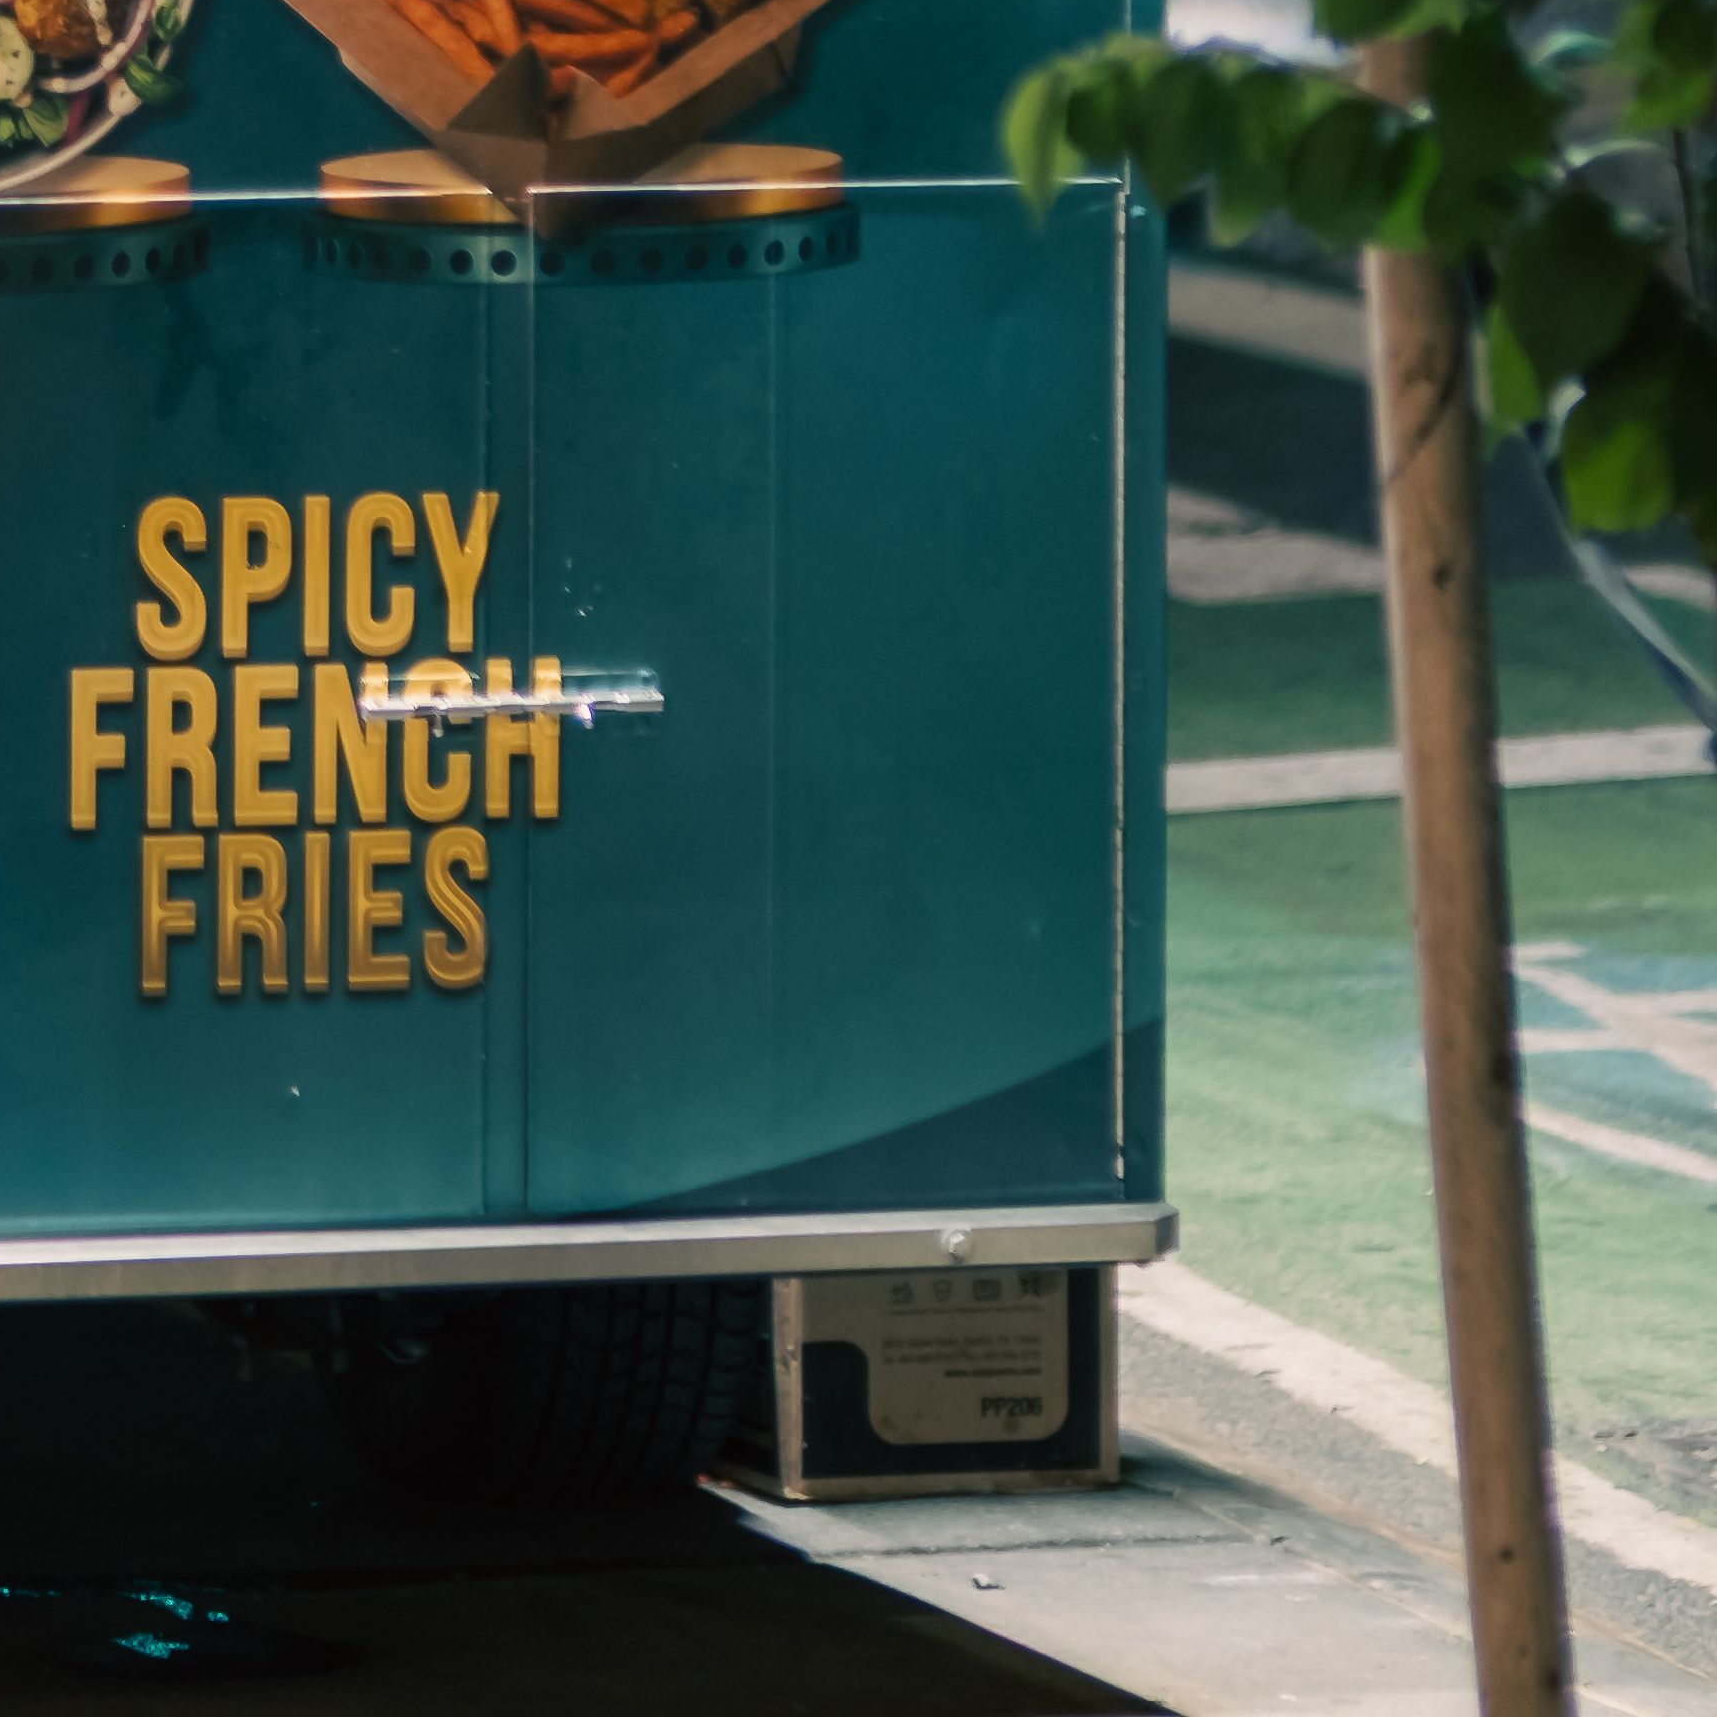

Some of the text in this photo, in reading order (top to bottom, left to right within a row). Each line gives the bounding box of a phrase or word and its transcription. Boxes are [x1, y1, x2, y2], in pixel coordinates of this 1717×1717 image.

[135, 491, 499, 660] SPICY
[69, 656, 562, 830] FRENCH
[141, 827, 489, 995] FRIES
